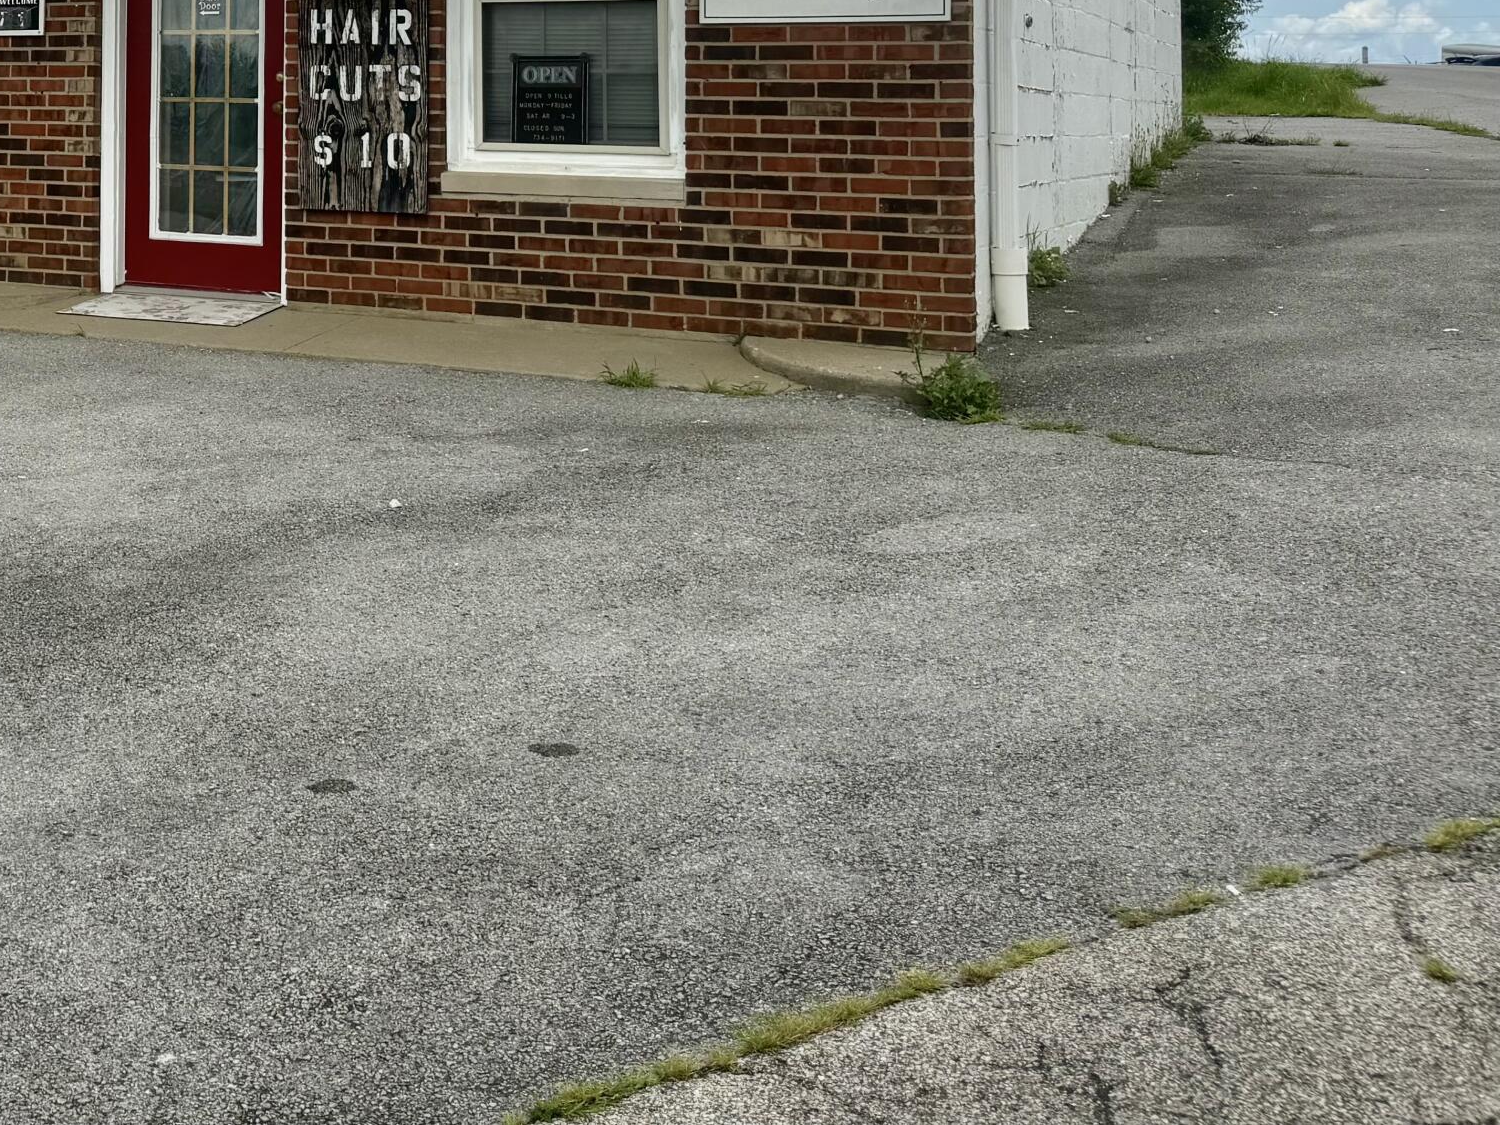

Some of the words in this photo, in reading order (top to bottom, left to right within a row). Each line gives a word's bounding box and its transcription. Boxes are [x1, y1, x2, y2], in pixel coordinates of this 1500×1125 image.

[199, 2, 221, 10] Door
[310, 9, 412, 45] HAIR
[310, 64, 421, 102] CUTS
[522, 65, 578, 84] OPEN
